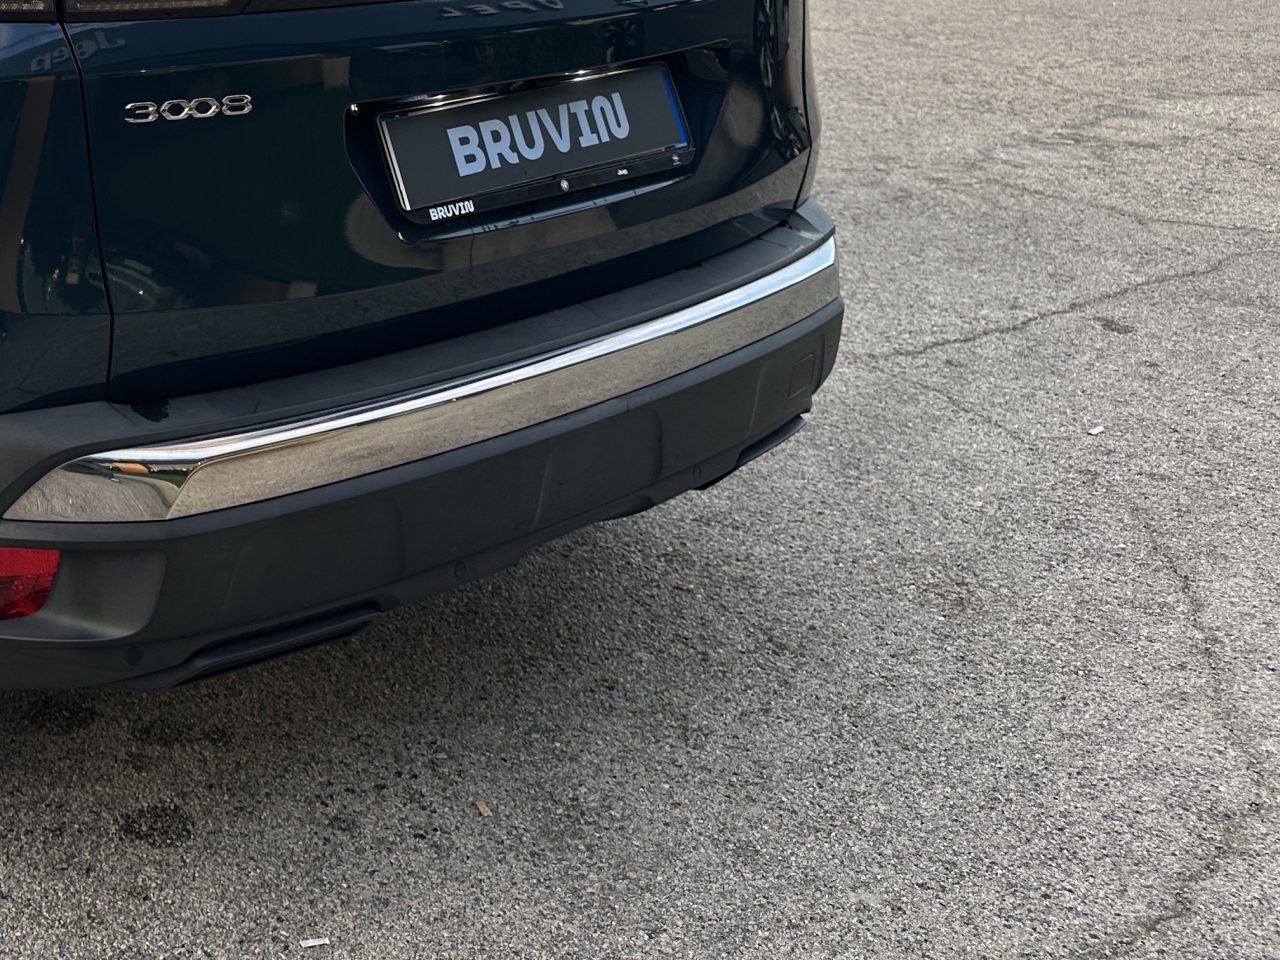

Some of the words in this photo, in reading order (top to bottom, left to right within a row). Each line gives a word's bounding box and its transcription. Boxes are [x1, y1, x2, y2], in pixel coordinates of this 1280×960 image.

[124, 94, 253, 124] 3008
[446, 91, 630, 177] BRUVIN
[428, 200, 475, 221] BRUVIN
